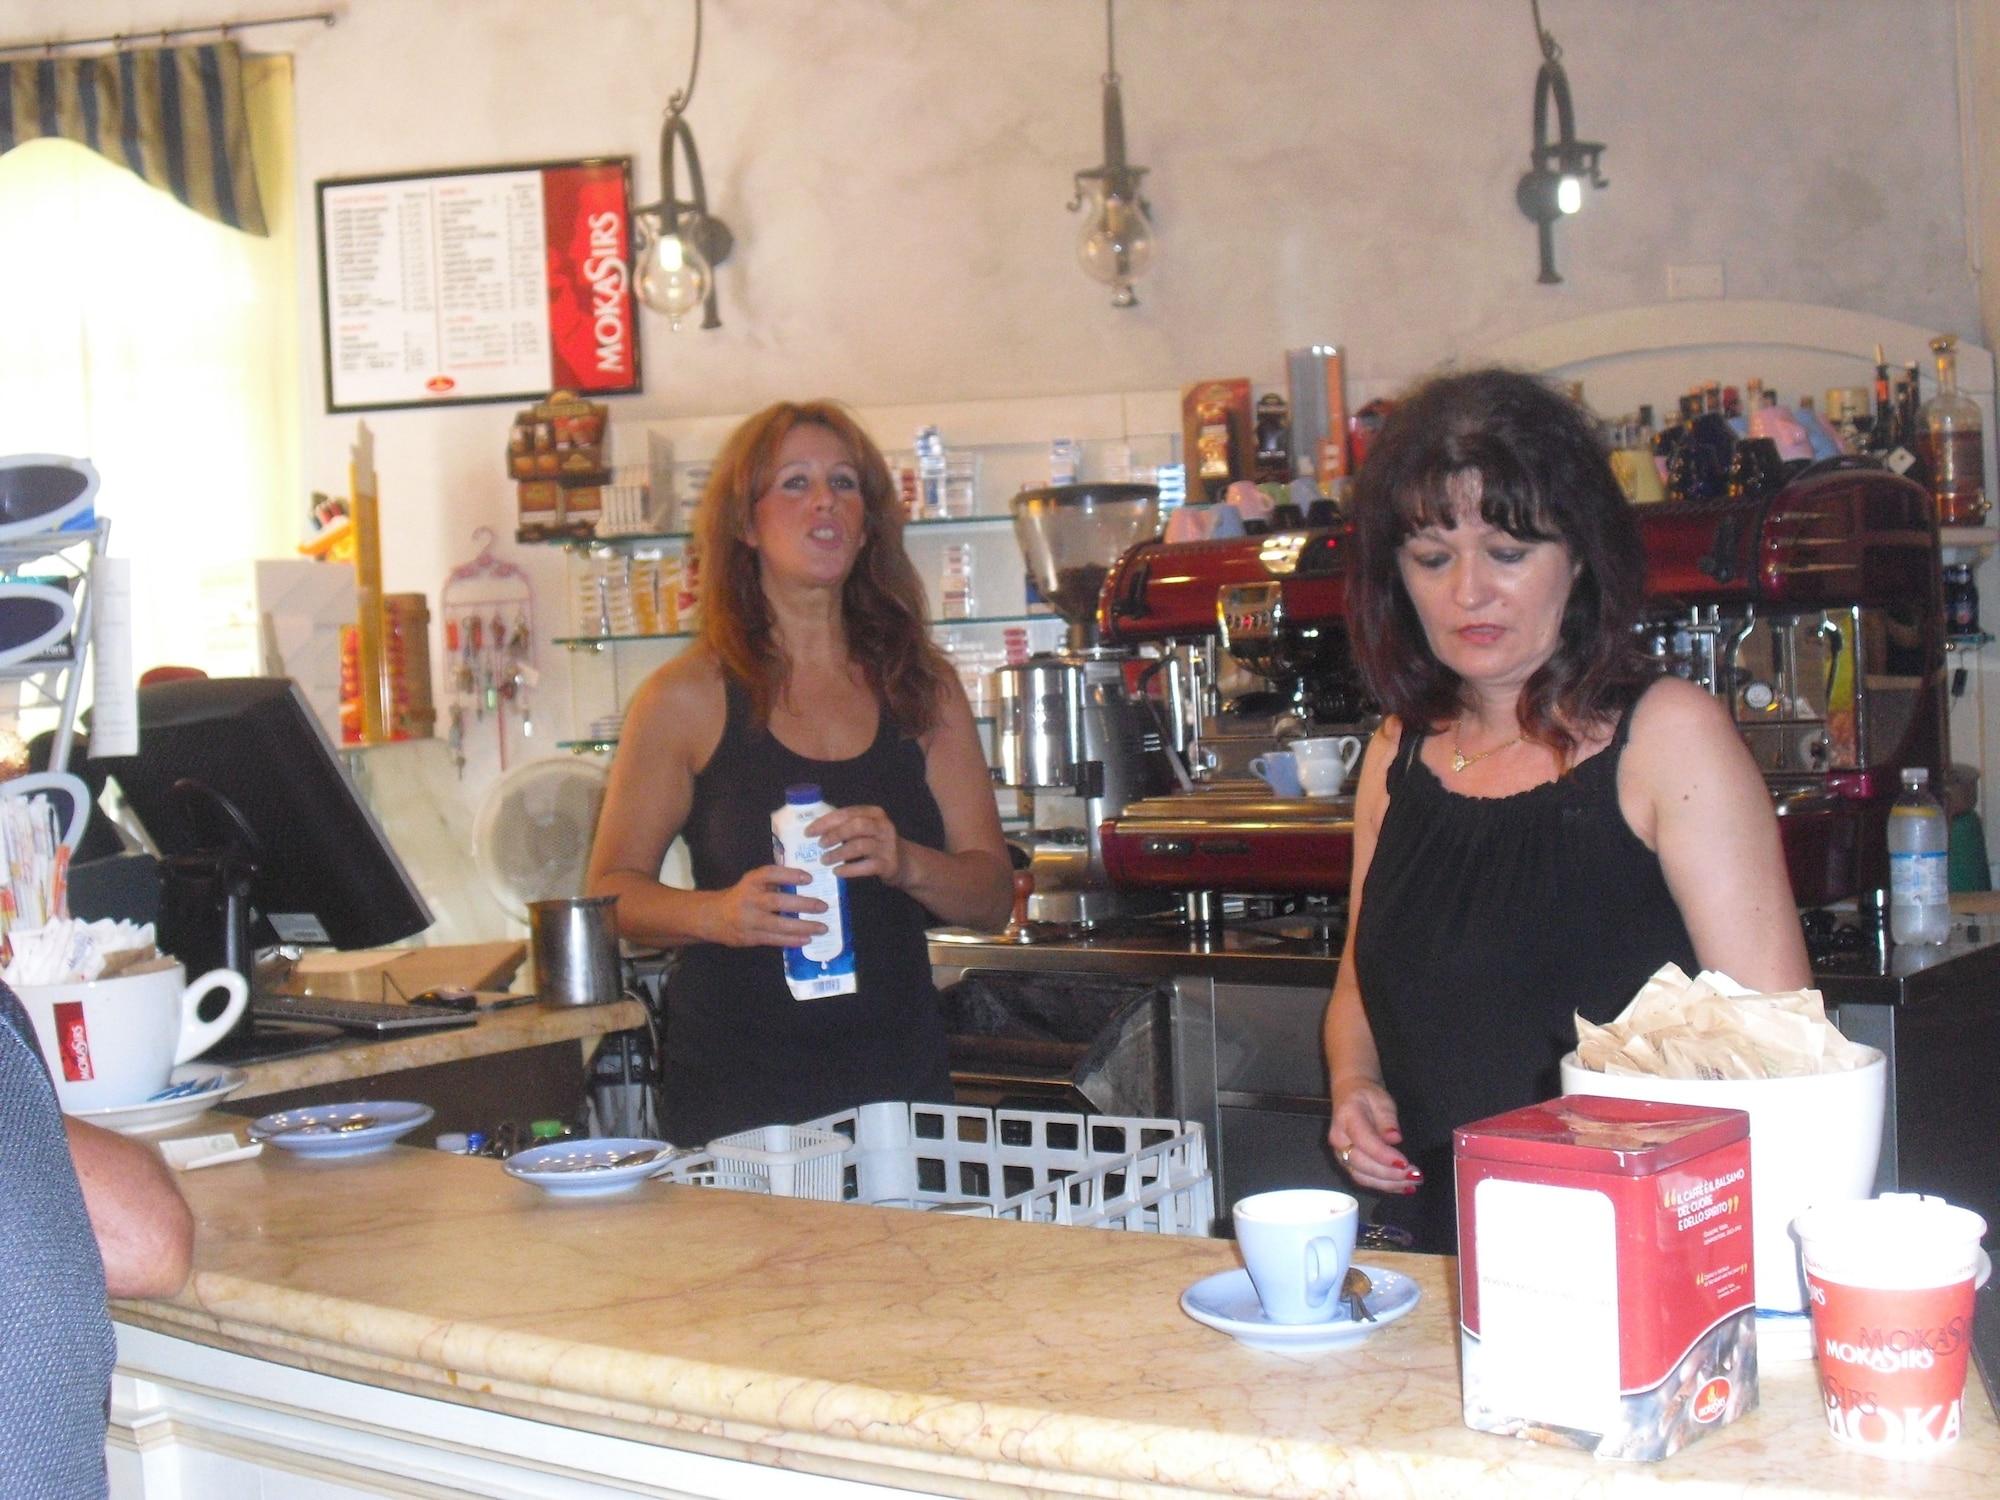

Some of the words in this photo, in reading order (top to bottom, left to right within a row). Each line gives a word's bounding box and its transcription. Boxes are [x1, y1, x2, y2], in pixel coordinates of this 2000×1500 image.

[583, 211, 628, 373] MOKASIRS
[1683, 1211, 1704, 1230] DELLO
[1825, 1338, 1935, 1374] MOKASIRS
